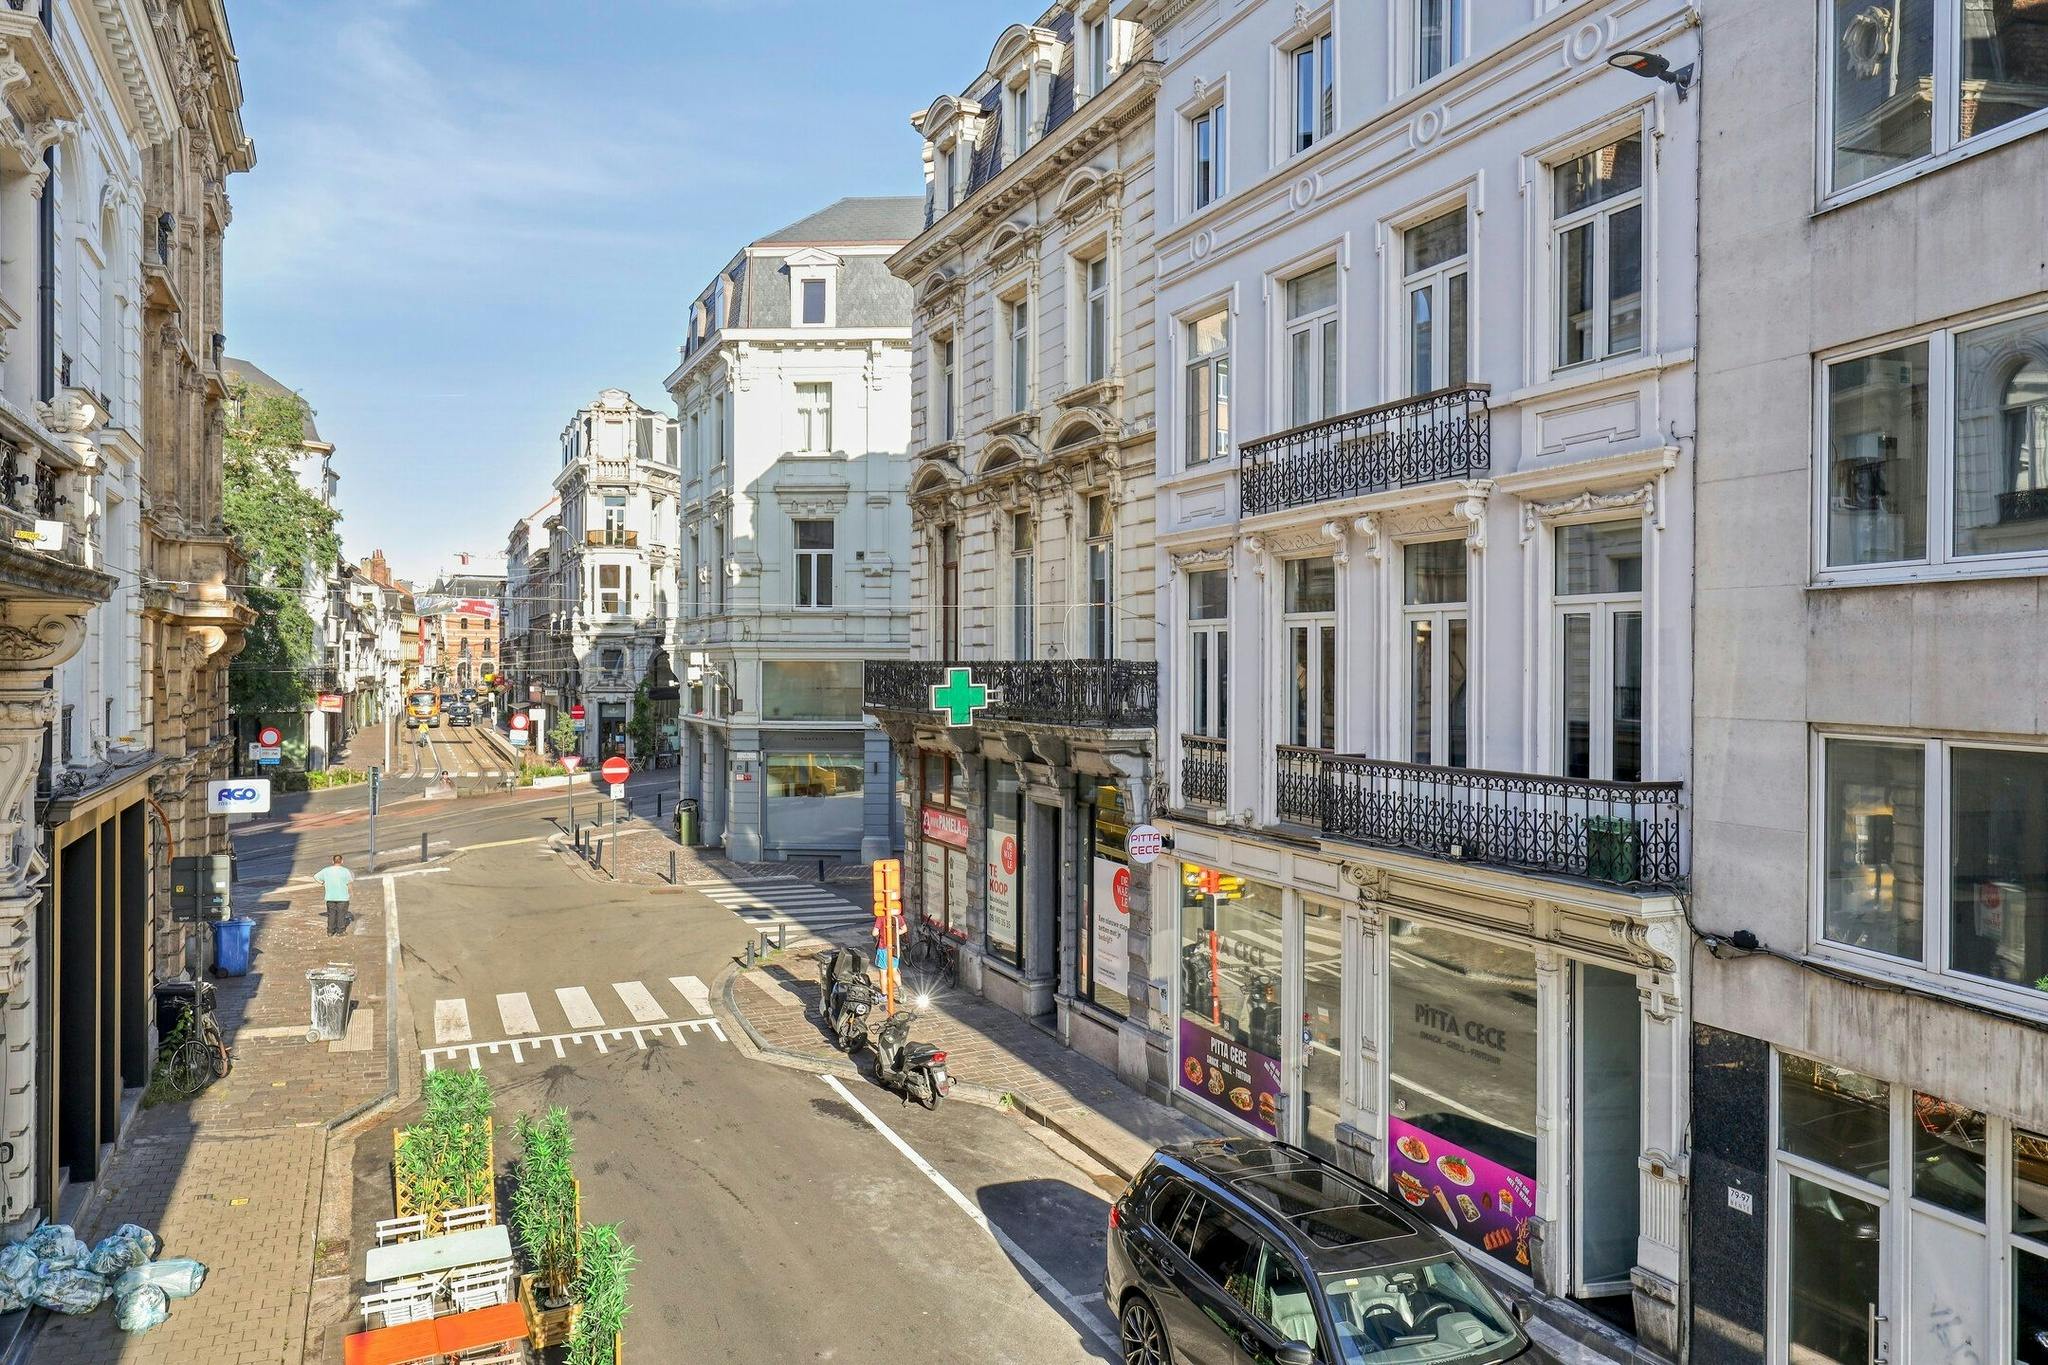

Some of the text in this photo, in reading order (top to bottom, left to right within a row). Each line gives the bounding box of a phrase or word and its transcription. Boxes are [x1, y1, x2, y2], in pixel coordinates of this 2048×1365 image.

[1131, 834, 1160, 842] PITTA
[1131, 845, 1160, 855] CECE
[989, 863, 998, 878] TE
[989, 879, 1008, 896] KOOP
[1465, 1020, 1507, 1052] CECE
[1210, 1036, 1248, 1068] PITTA CECE
